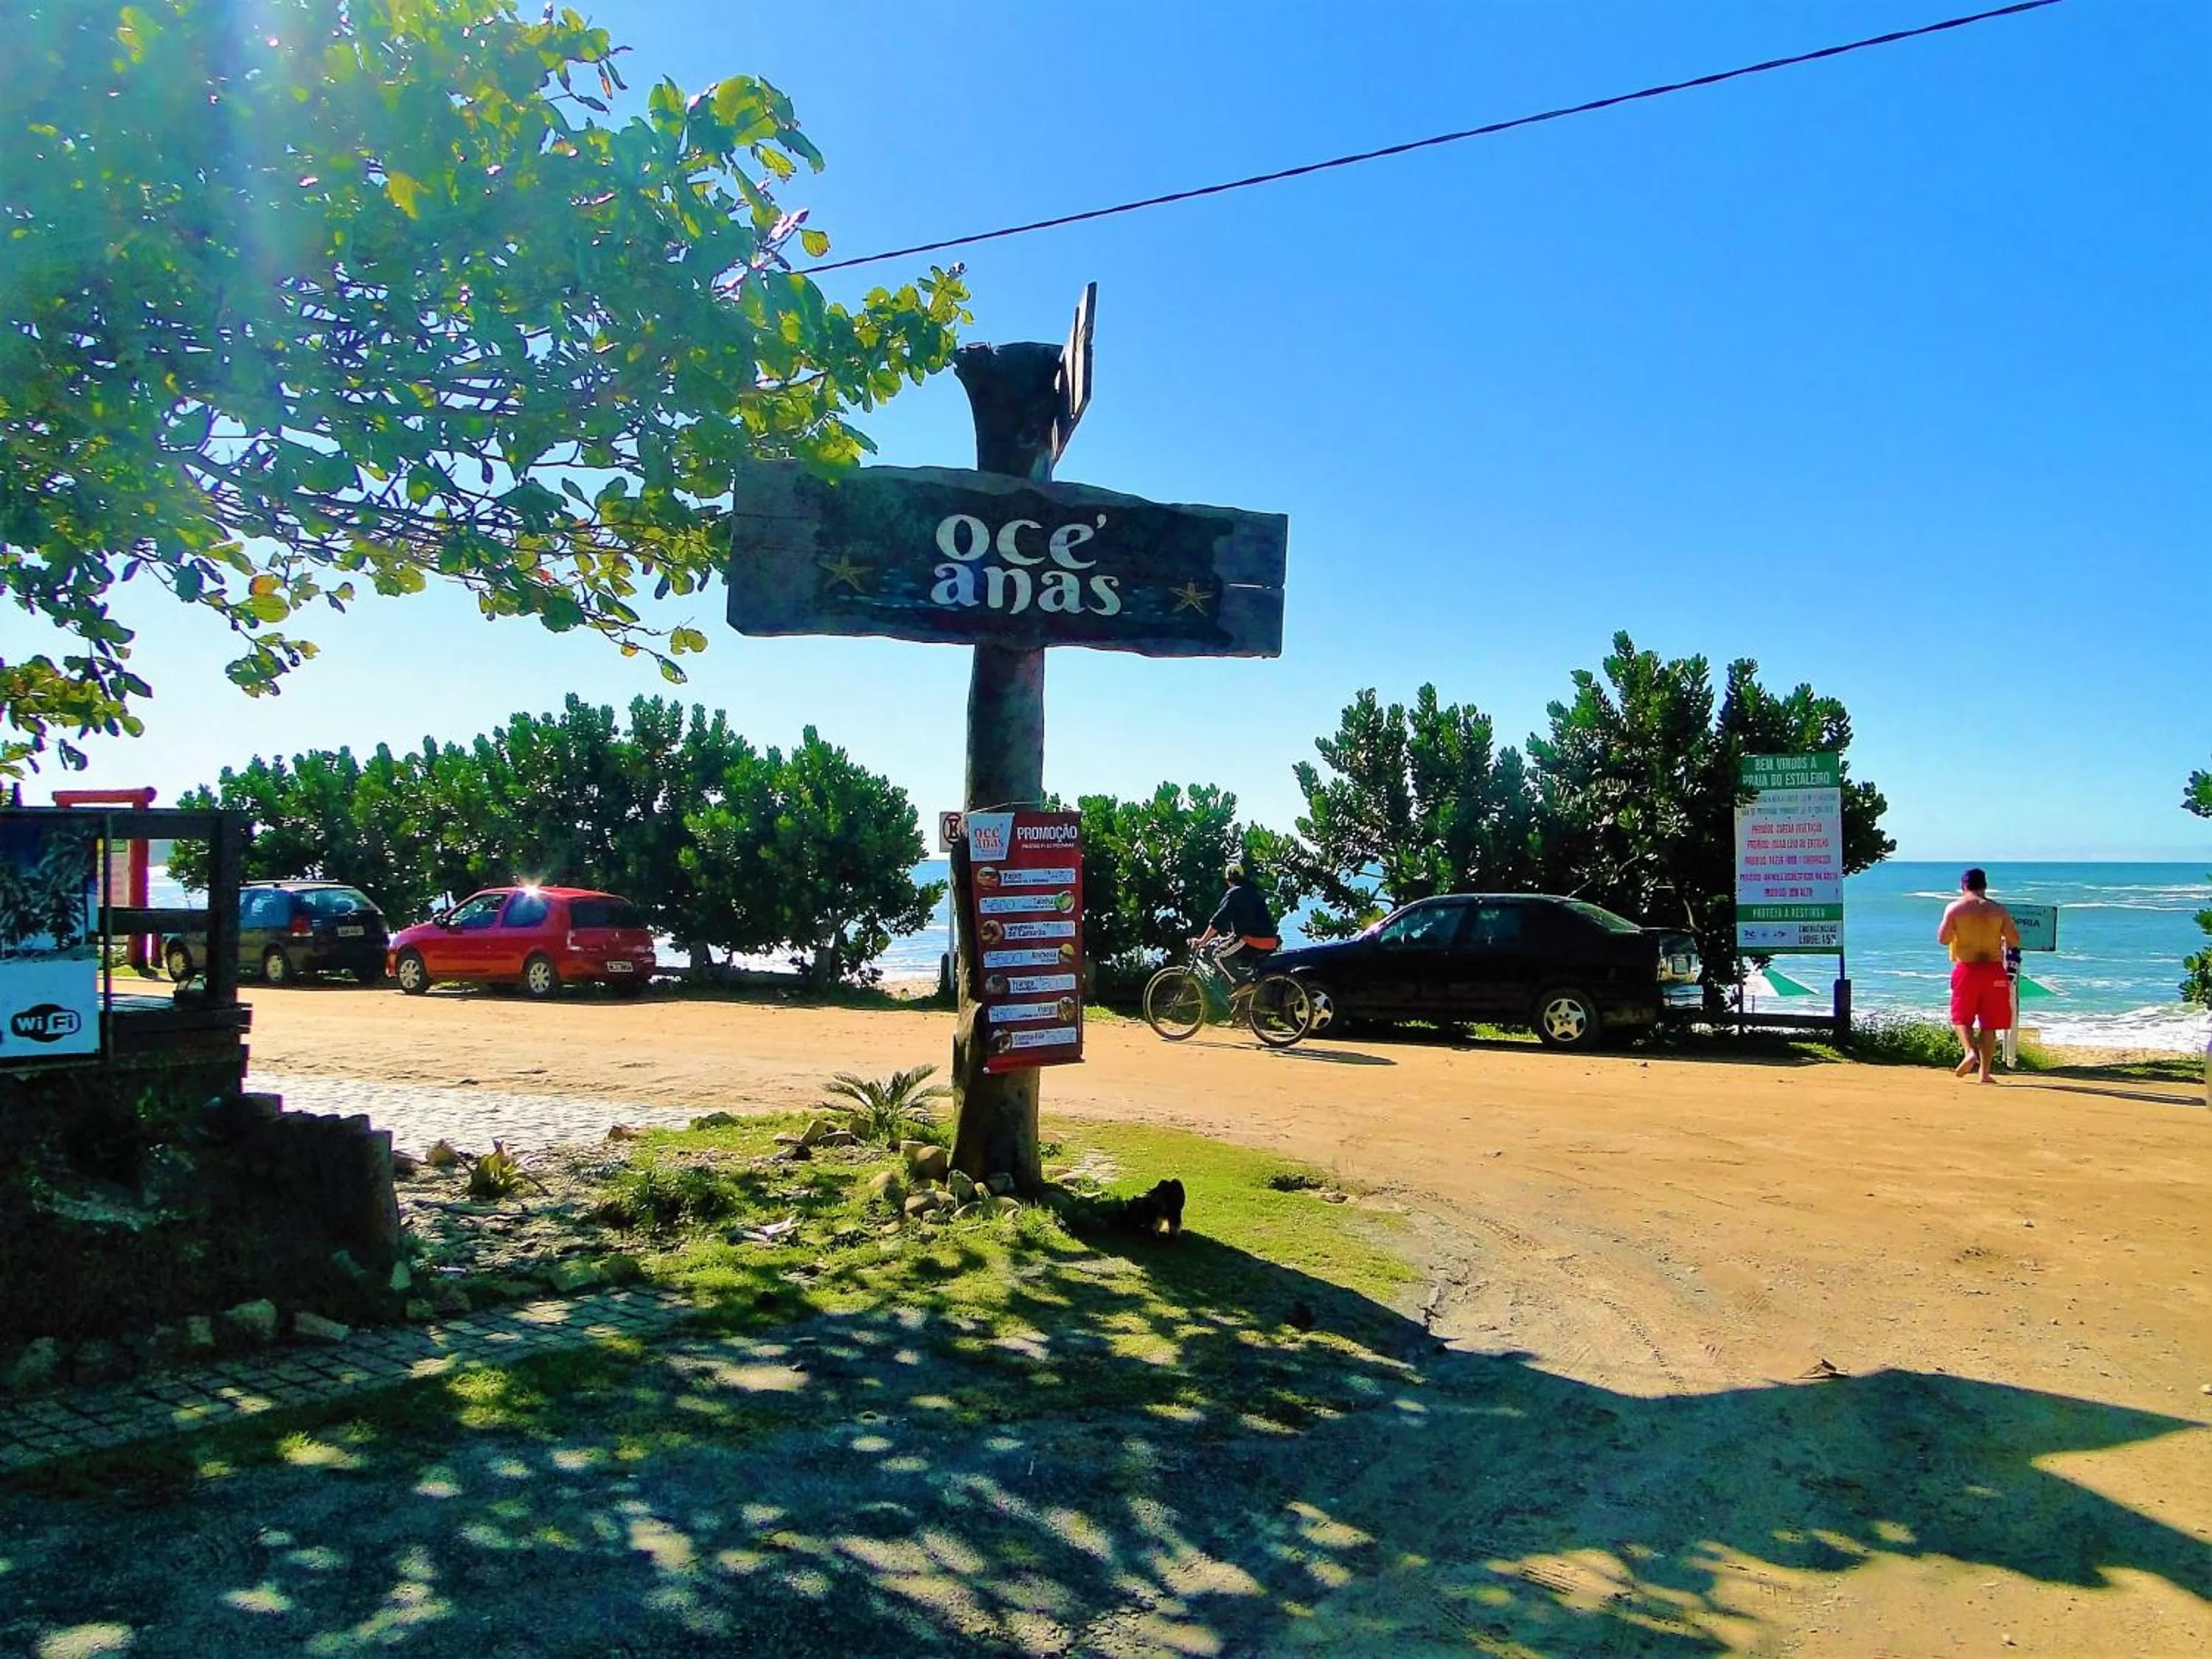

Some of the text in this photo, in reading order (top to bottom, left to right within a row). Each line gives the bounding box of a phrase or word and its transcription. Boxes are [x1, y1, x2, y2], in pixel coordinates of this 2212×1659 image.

[930, 563, 1121, 616] anas
[1754, 756, 1818, 771] BEM VINDOS A
[1742, 771, 1830, 787] PRAIA DO ESTALEIRO
[1017, 822, 1077, 842] PROMOÇÃO
